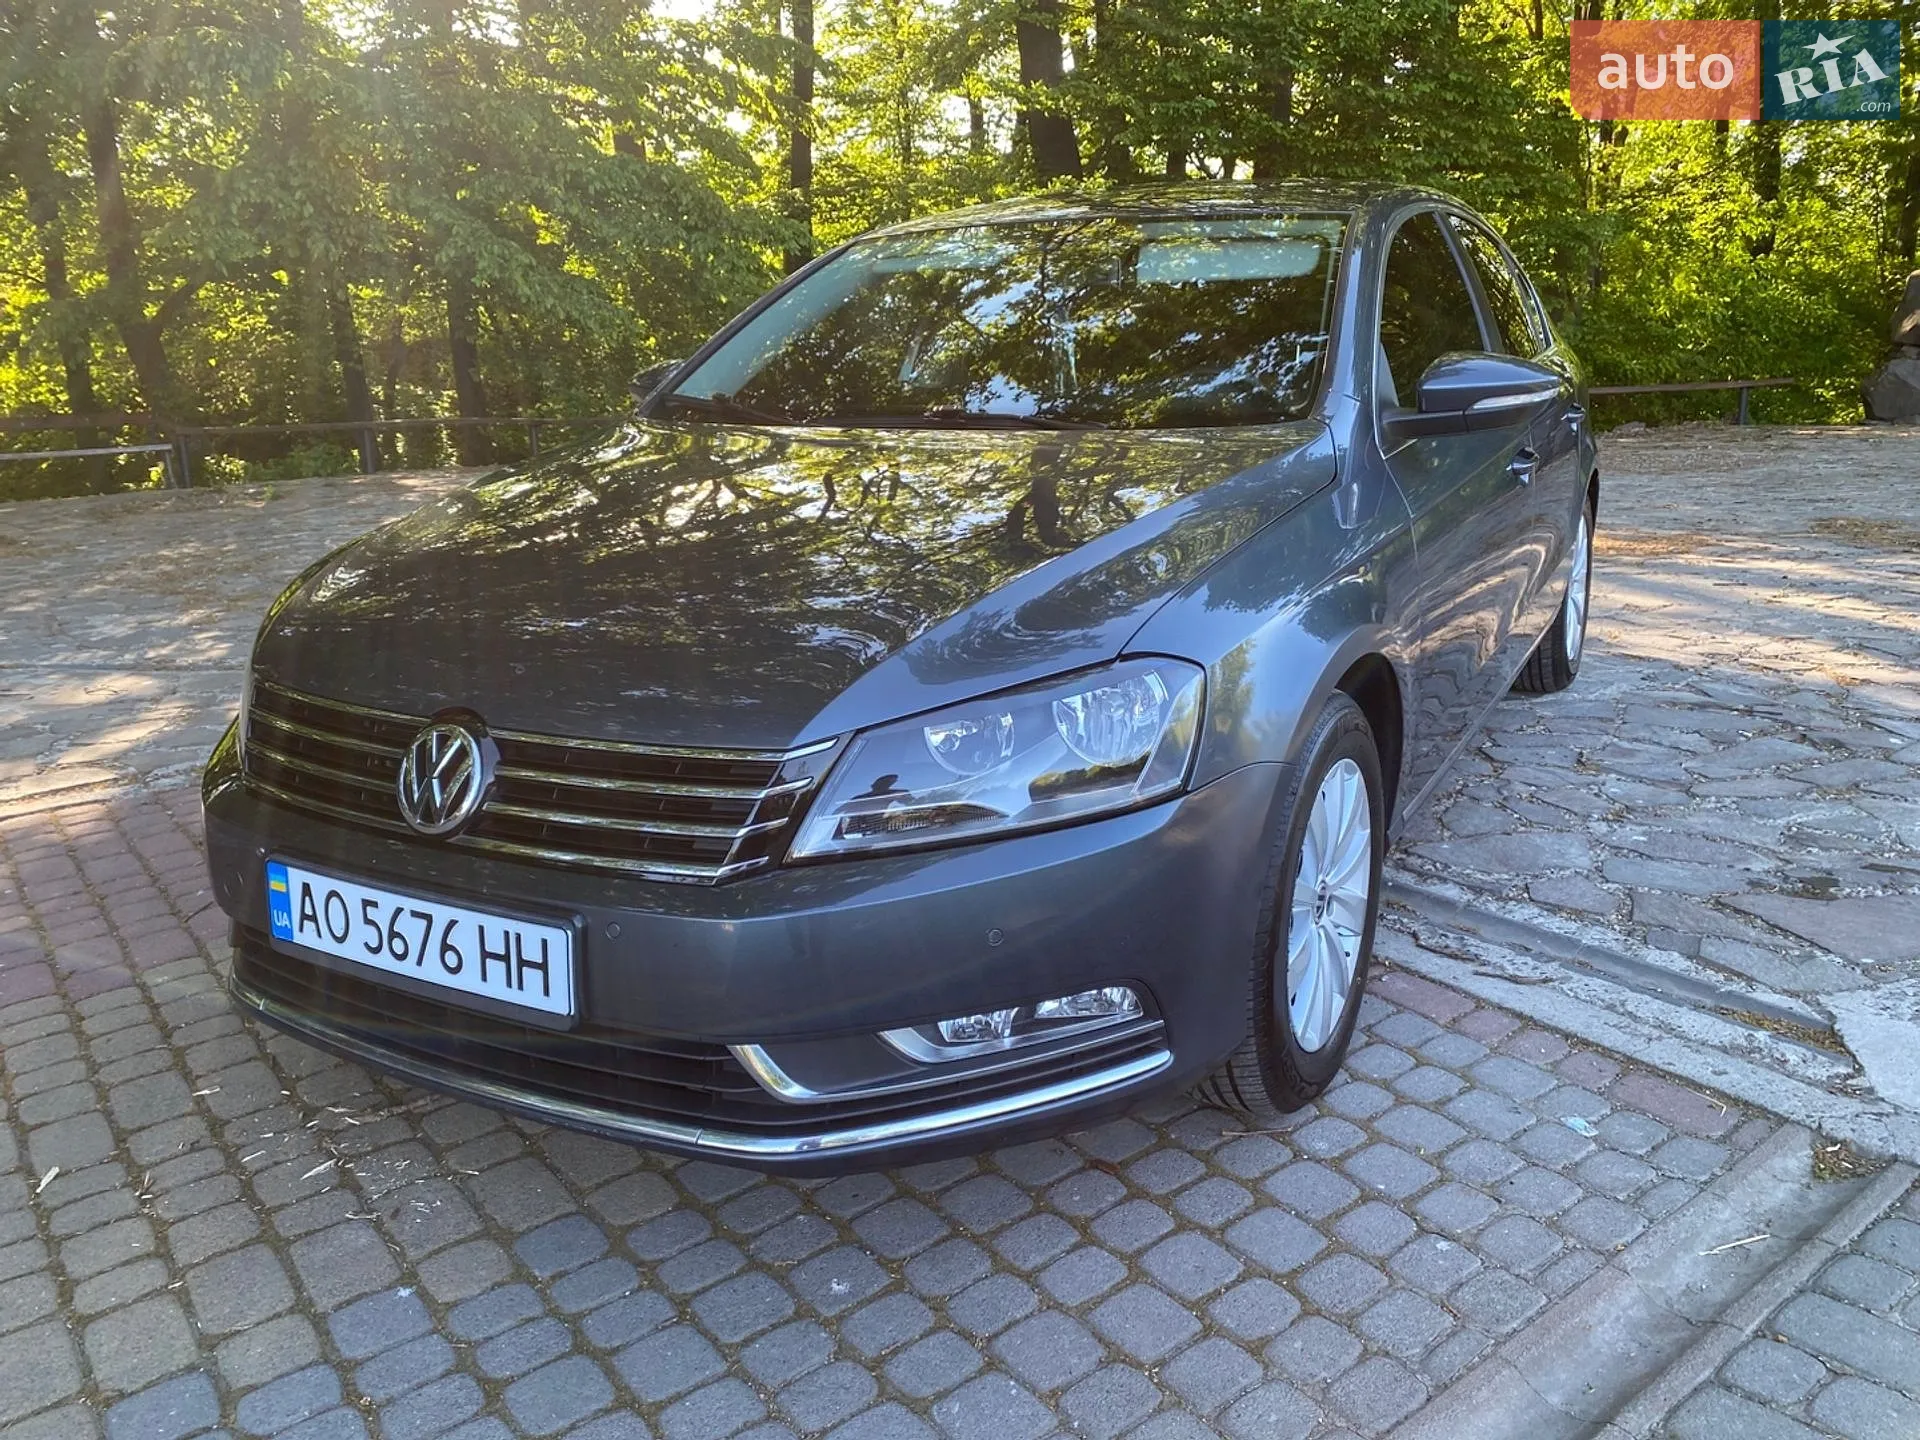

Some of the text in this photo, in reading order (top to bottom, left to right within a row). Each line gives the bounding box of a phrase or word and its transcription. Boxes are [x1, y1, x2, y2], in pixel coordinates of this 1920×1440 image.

[273, 909, 292, 929] UA
[299, 881, 550, 998] AO 5676 HH
